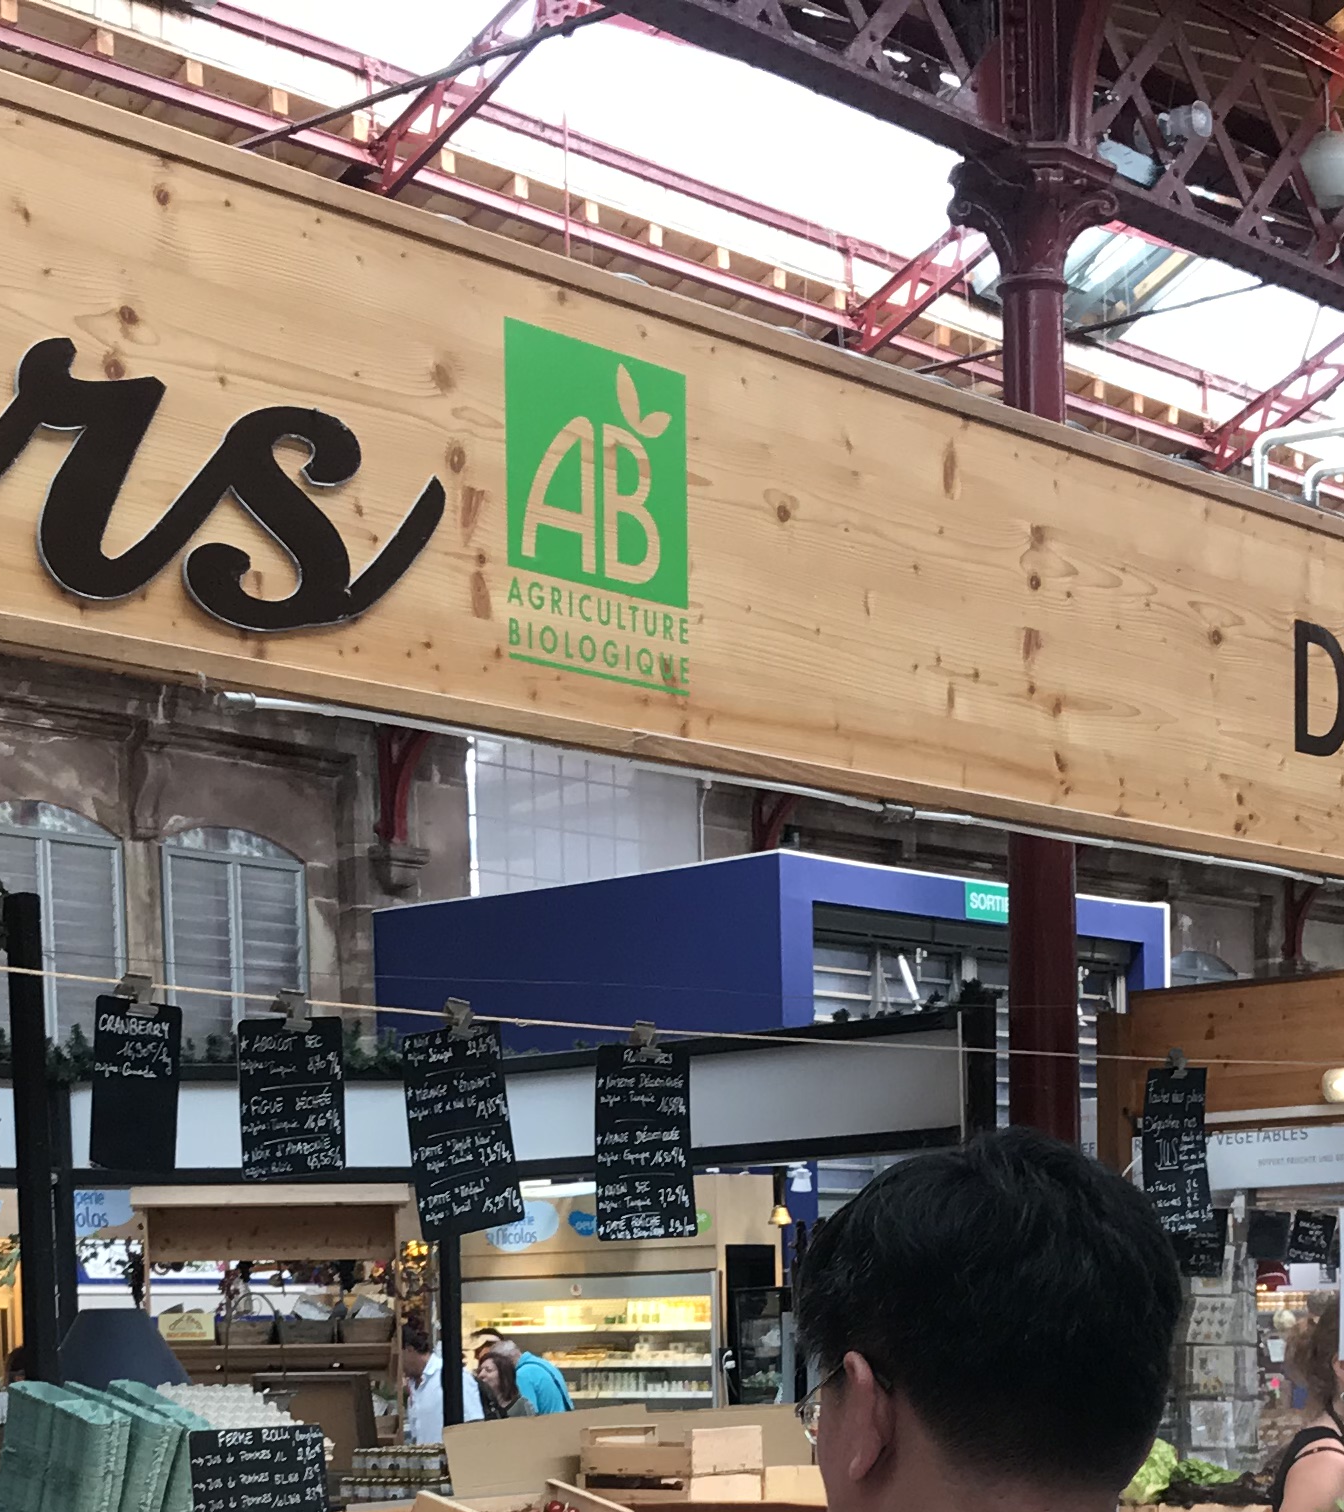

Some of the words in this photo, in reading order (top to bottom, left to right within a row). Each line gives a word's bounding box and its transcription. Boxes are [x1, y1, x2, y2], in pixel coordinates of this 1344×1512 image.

[521, 416, 661, 585] AB
[507, 576, 690, 645] AGRICULTURE
[508, 618, 690, 685] BIOLOGIQUE
